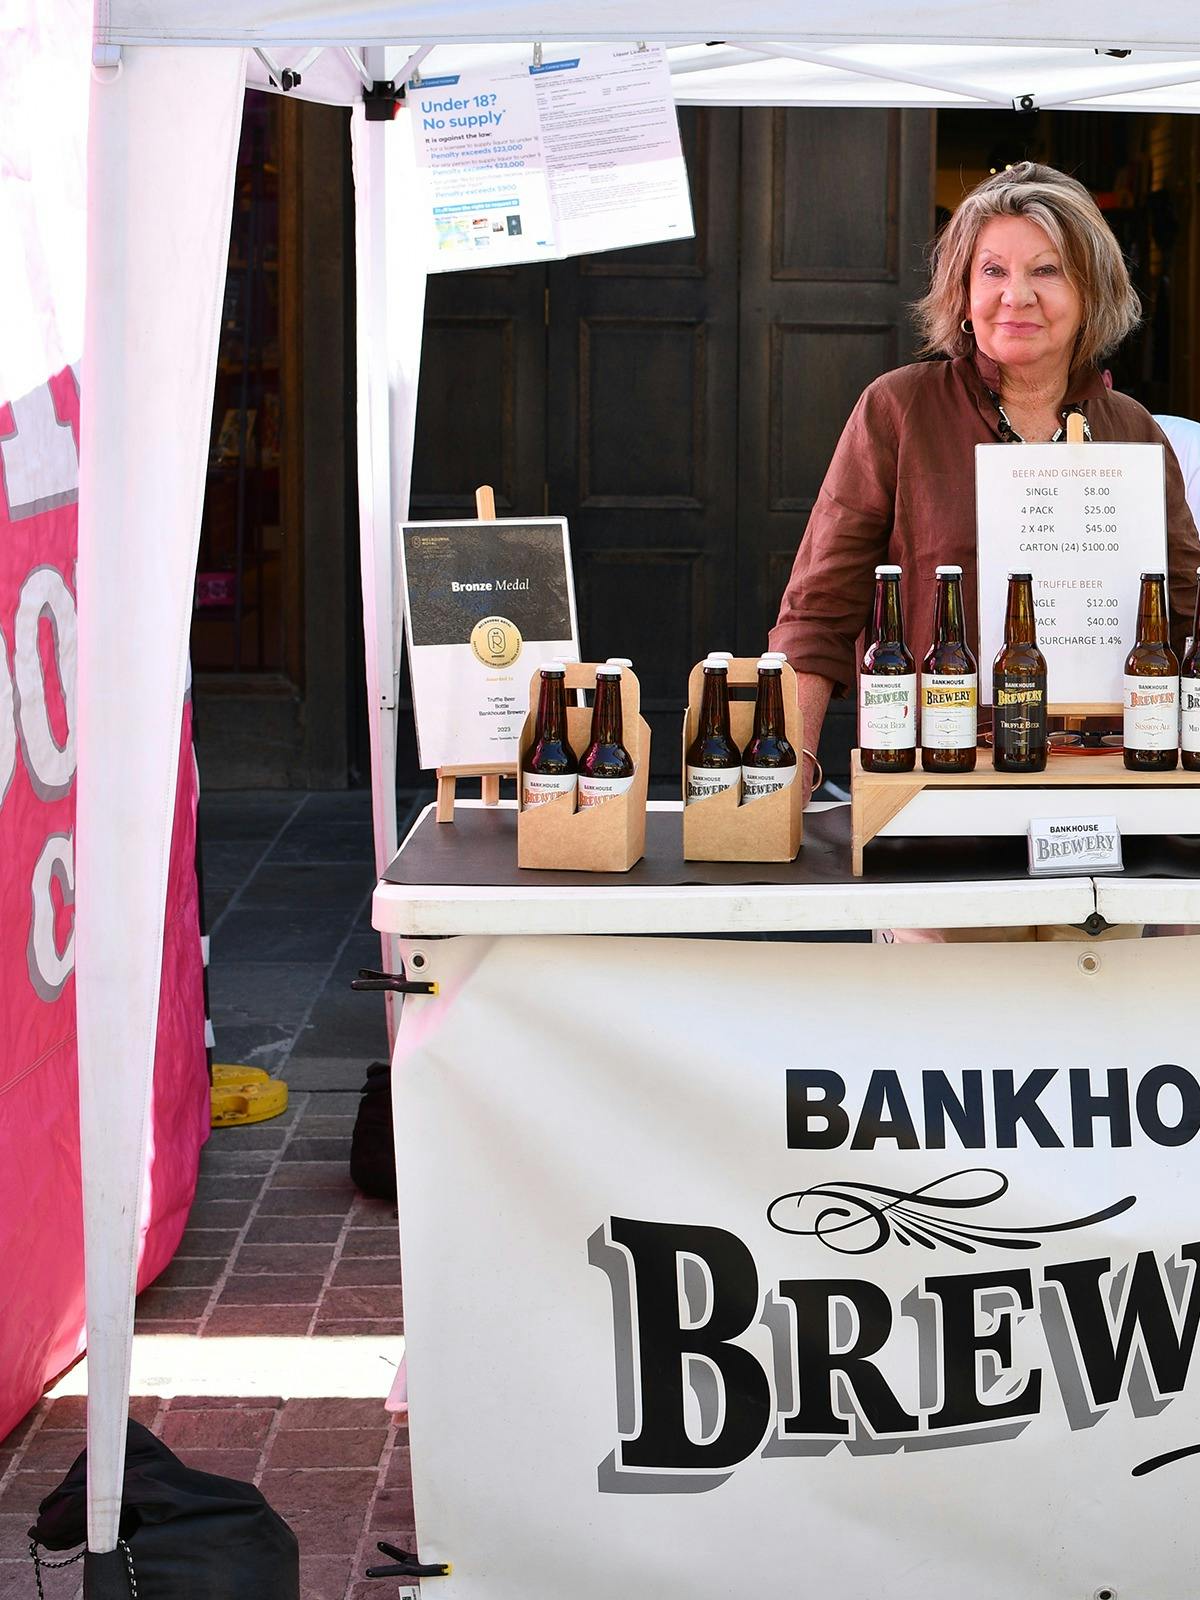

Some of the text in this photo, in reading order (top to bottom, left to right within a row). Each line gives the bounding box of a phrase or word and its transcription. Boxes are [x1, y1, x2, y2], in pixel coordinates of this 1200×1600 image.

[421, 93, 497, 114] Under 18?
[423, 118, 445, 130] No
[439, 135, 464, 143] against
[431, 151, 459, 160] Penalty
[461, 148, 491, 156] exceeds
[493, 144, 523, 153] $23,000
[1012, 469, 1123, 478] BEER AND GINGER BEER
[1026, 486, 1110, 497] SINGLE $8.00
[1021, 505, 1116, 515] 4 PACK $25.00
[1021, 523, 1117, 534] 2 X 4PK $45.00
[1019, 542, 1119, 553] CARTON (24) $100.00
[451, 578, 530, 593] Bronze Medal
[1037, 580, 1103, 589] TRUFFLE BEER
[1033, 599, 1118, 608] NGLE $12.00
[1087, 617, 1119, 626] $40.00
[1039, 636, 1122, 645] SURCHARGE 1.4%
[864, 690, 910, 706] BREWERY
[926, 690, 971, 705] BREWERY
[997, 690, 1043, 705] BREWERY
[1130, 692, 1175, 707] BREWERY
[1050, 824, 1099, 833] BANKHOUSE
[1035, 834, 1115, 862] BREWERY
